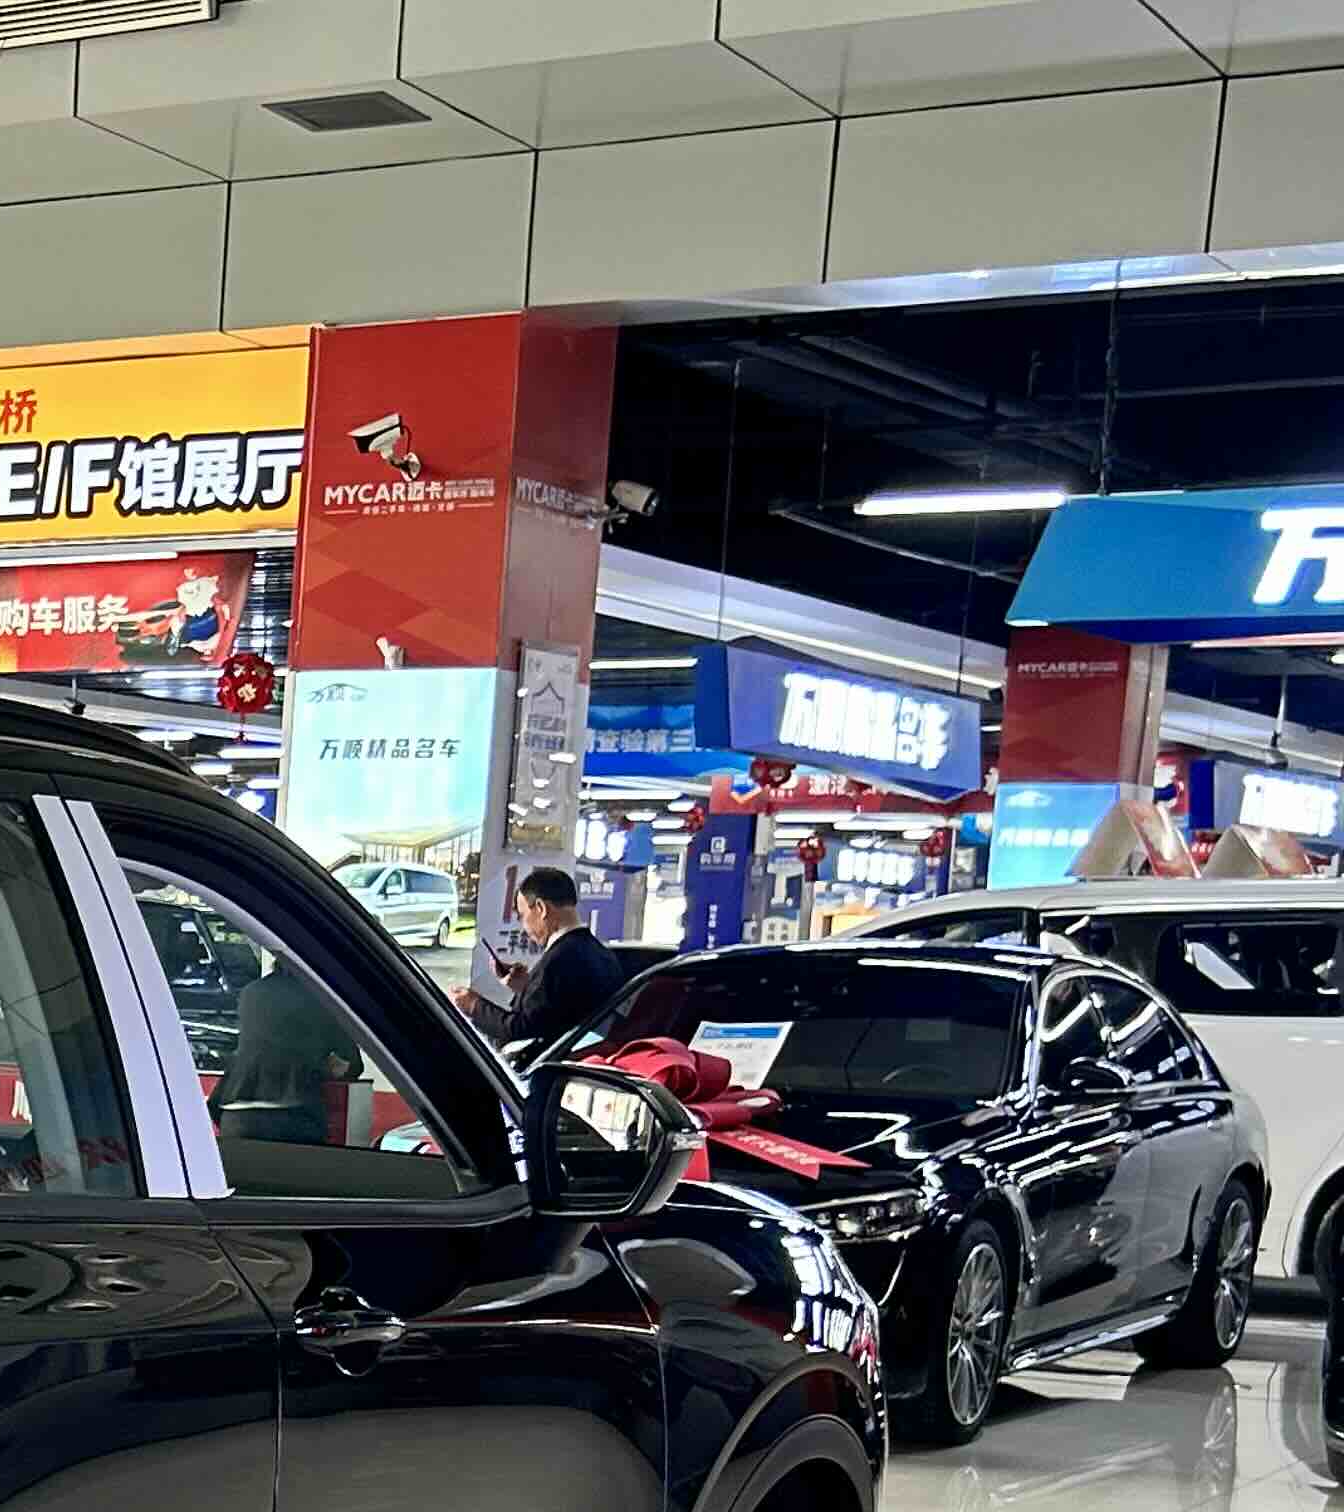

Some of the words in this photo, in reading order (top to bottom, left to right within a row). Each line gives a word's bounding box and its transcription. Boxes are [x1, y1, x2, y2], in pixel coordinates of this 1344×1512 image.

[318, 738, 462, 760] 万顺精品名车
